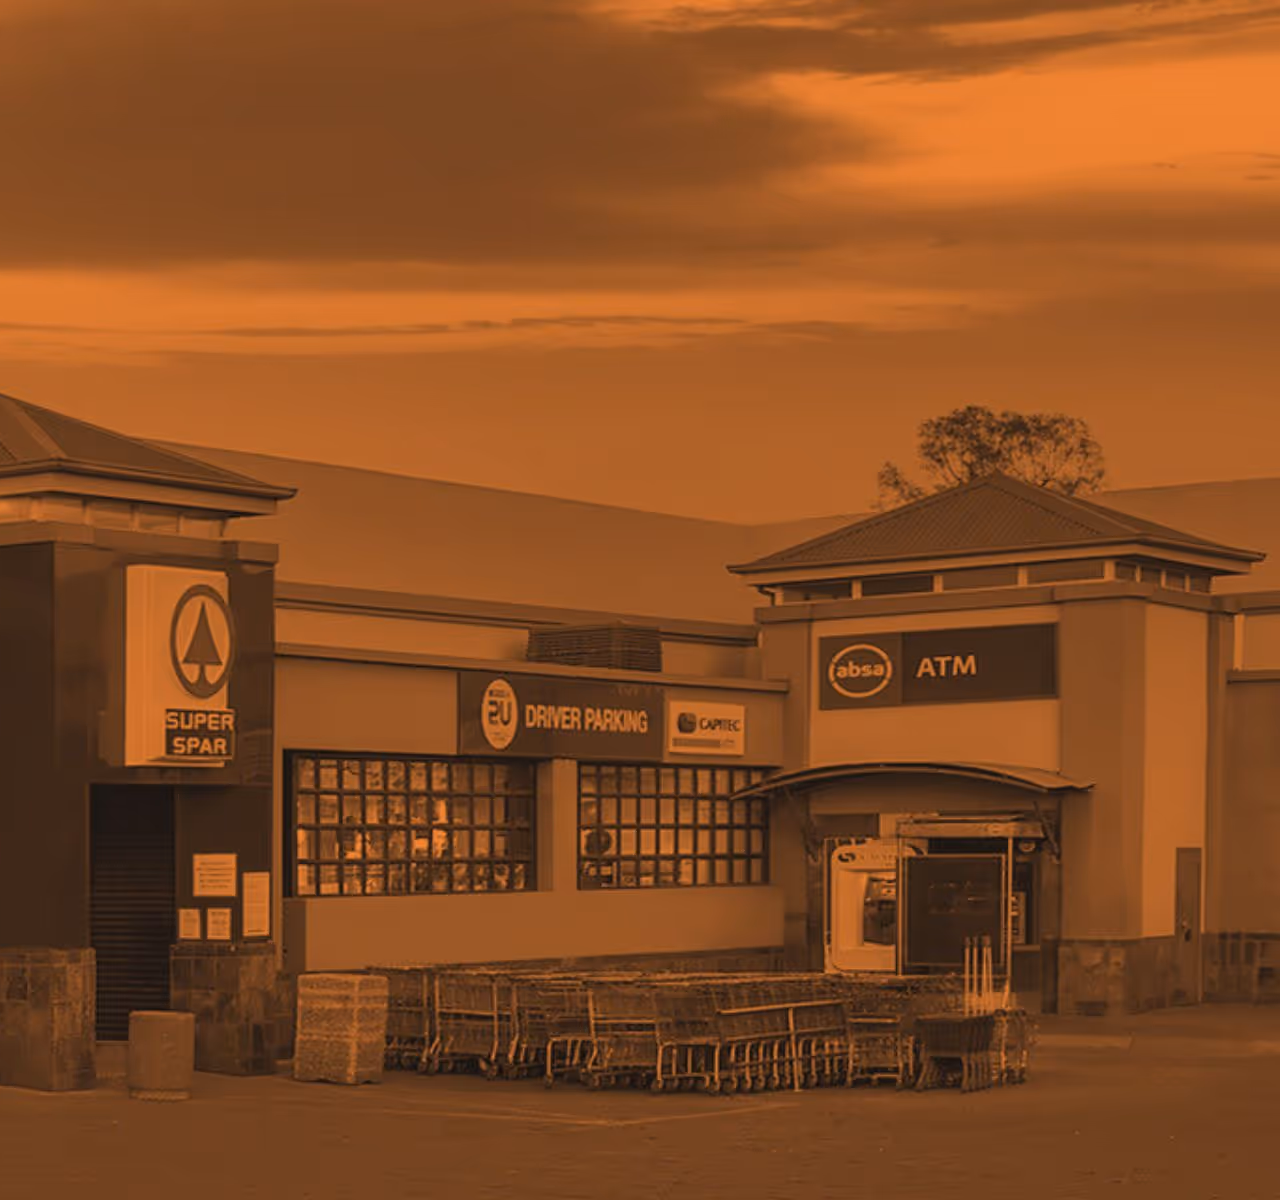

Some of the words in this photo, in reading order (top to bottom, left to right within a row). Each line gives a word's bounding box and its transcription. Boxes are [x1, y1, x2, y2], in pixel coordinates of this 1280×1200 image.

[836, 661, 884, 679] absa
[916, 655, 977, 678] ATM
[166, 711, 235, 731] SUPER
[525, 704, 582, 730] DRIVER
[584, 707, 648, 733] PARKING
[173, 737, 227, 755] SPAR
